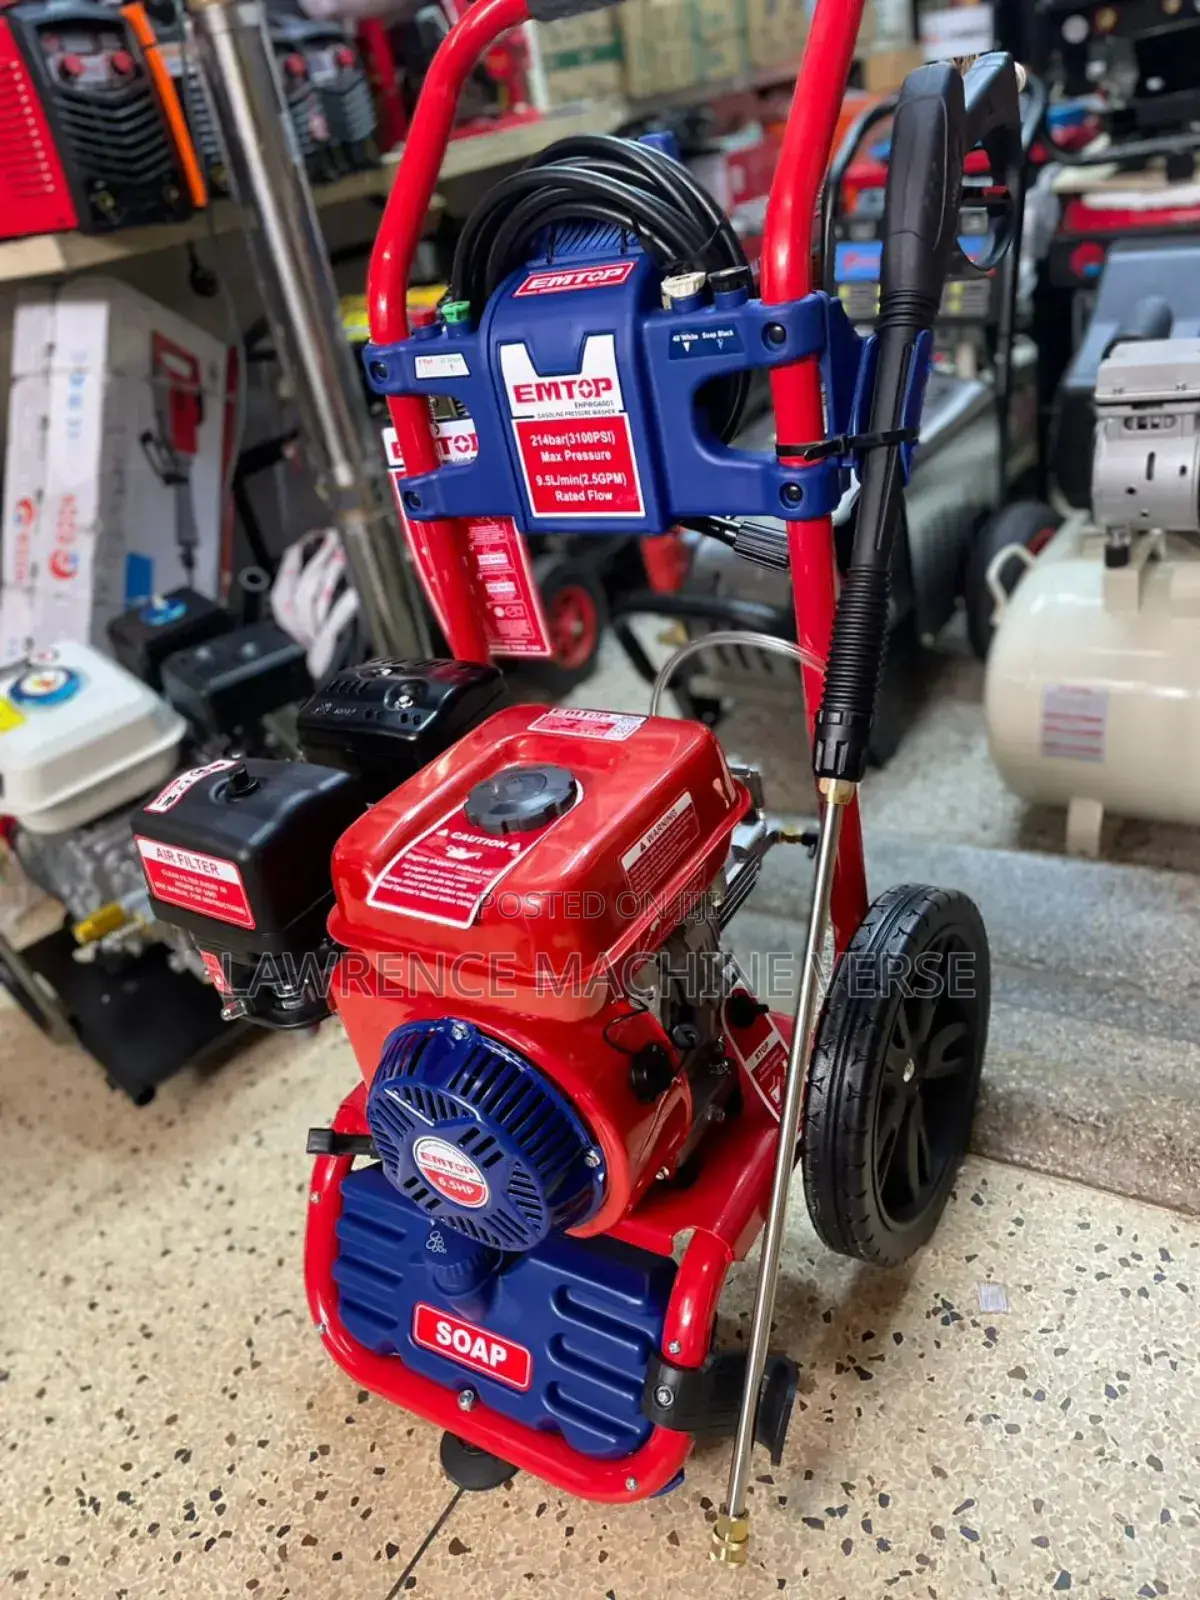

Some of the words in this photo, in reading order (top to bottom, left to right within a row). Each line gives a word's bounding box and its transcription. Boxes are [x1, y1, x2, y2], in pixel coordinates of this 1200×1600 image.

[528, 268, 624, 290] EMTOP
[702, 331, 717, 340] Soap
[717, 329, 734, 338] Black
[513, 378, 613, 404] EMTOP
[537, 410, 564, 419] GASOLINE
[564, 409, 591, 417] PRESSURE
[592, 408, 616, 416] WASHER
[530, 430, 616, 447] 214bar(3100PSI)
[540, 450, 563, 463] Max
[564, 449, 612, 462] Pressure
[535, 472, 627, 487] 9.5L/min(2.5GPM)
[554, 489, 585, 502] Rated
[587, 488, 613, 501] Flow
[646, 809, 677, 843] WARNING
[451, 832, 509, 849] CAUTION
[156, 847, 176, 863] AIR
[177, 853, 221, 876] FILTER
[754, 1041, 770, 1061] STOP
[420, 1151, 475, 1175] EMTOP
[438, 1177, 475, 1195] 6.5HP
[435, 1321, 508, 1368] SOAP
